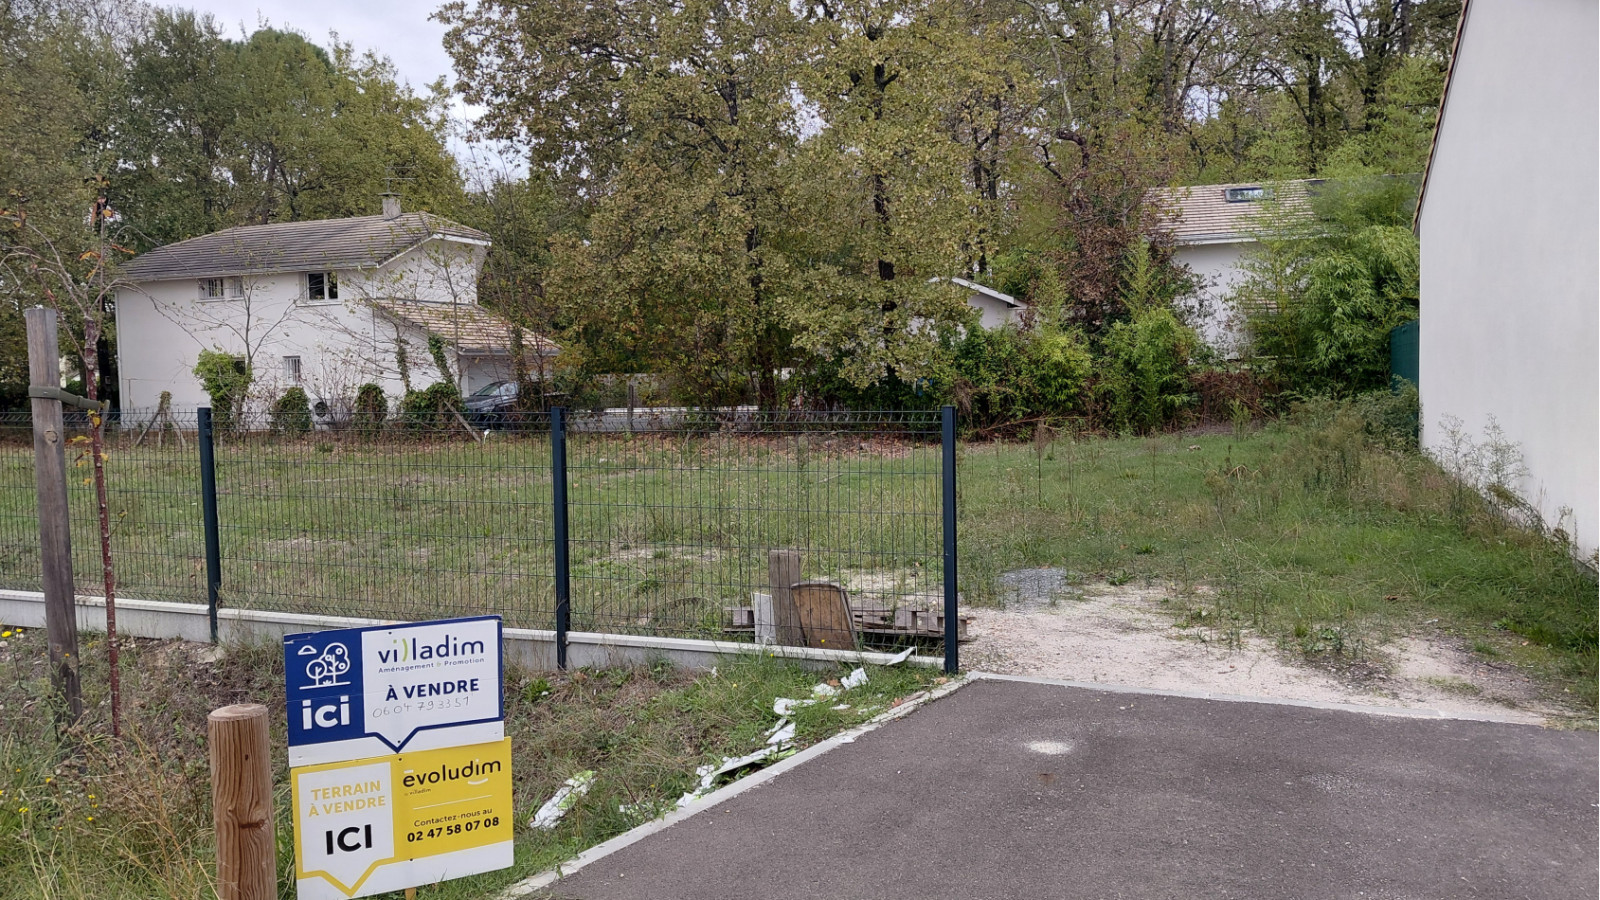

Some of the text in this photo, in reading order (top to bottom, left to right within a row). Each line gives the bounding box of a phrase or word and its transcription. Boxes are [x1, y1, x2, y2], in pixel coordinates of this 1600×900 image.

[378, 662, 435, 673] Aménagement
[444, 657, 485, 666] Promotion
[385, 678, 480, 702] À VENDRE
[302, 695, 350, 730] ici
[311, 780, 381, 801] TERRAIN
[308, 795, 386, 818] À VENDRE
[407, 816, 500, 843] 02 47 58 07 08
[413, 810, 481, 828] Contactez-nous
[325, 824, 372, 856] ICI
